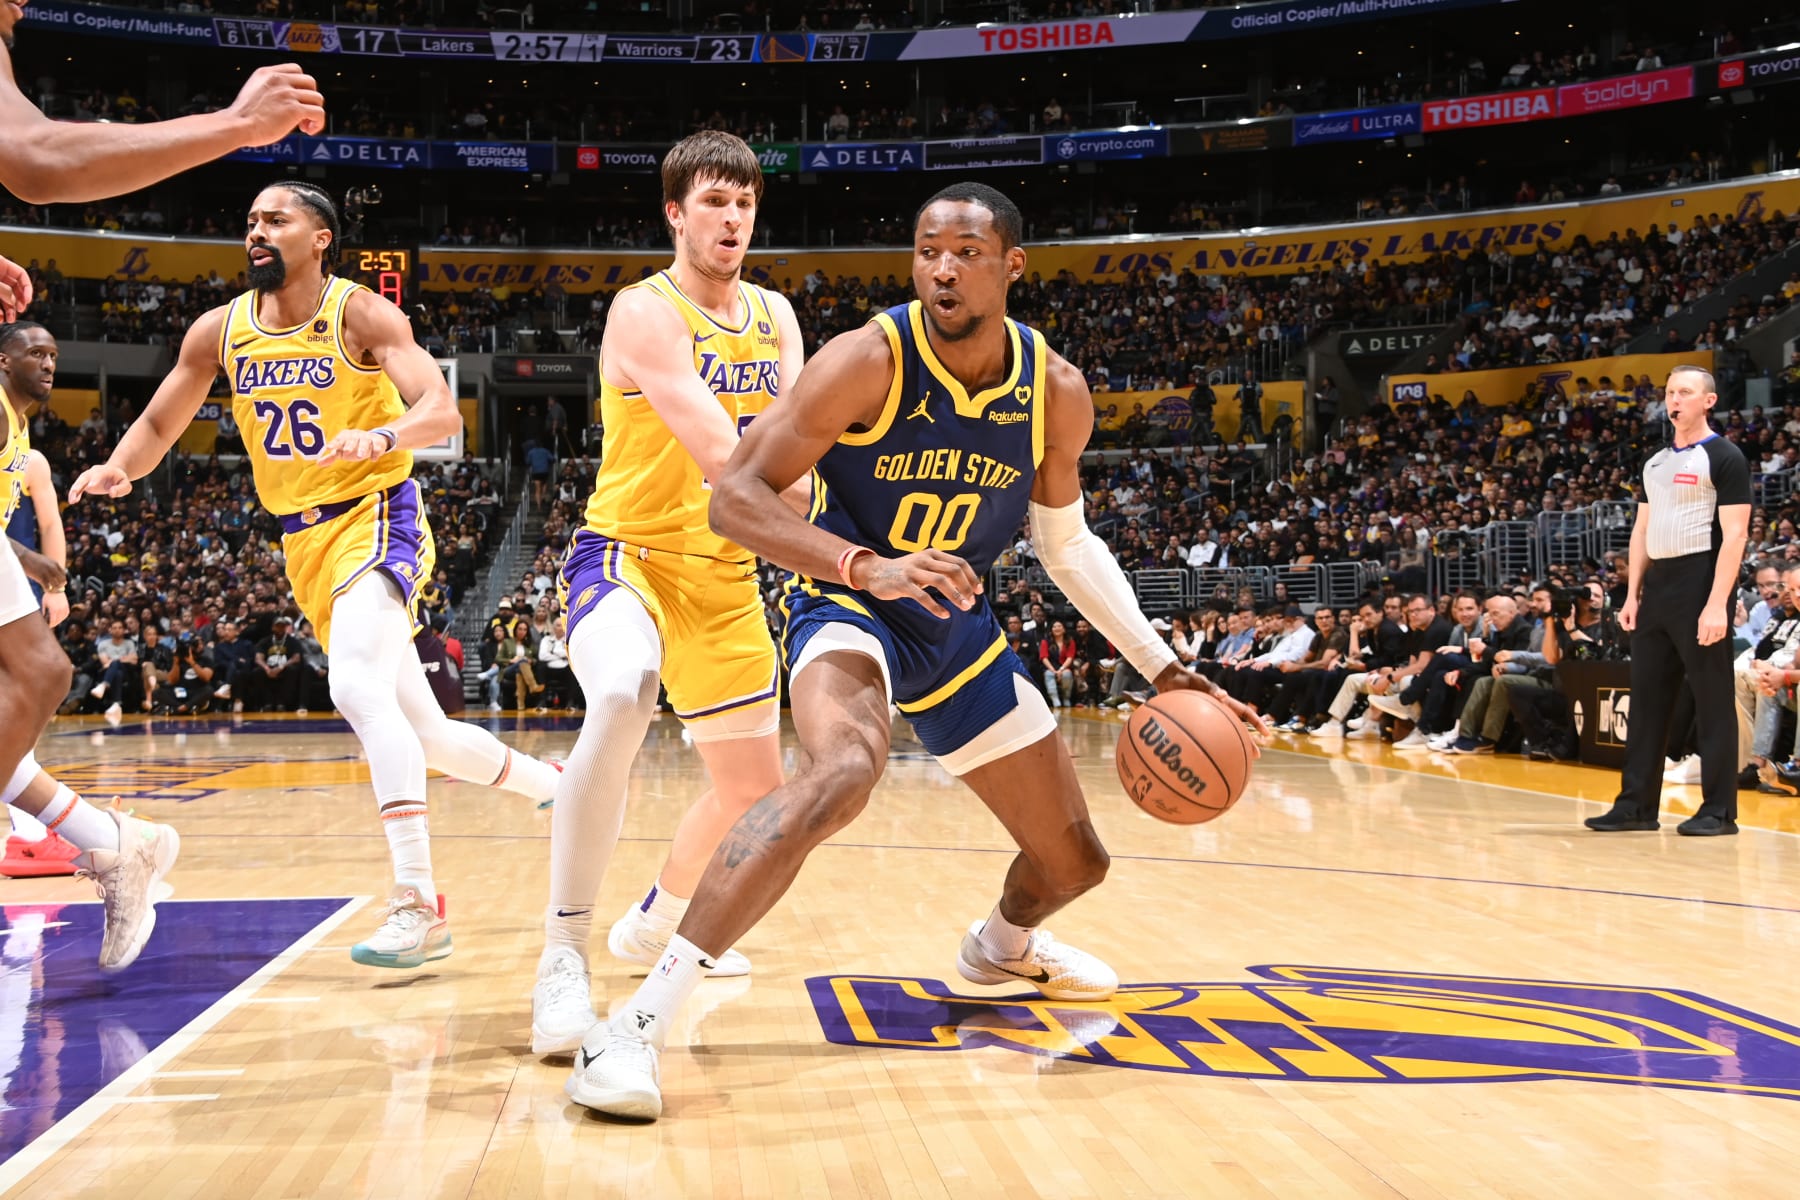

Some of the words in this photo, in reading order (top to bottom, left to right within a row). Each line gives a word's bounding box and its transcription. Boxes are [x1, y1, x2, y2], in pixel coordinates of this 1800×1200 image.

[23, 7, 69, 23] fficial
[73, 12, 212, 37] Copier/Multi-Func
[1232, 12, 1282, 29] Official
[228, 30, 238, 44] 6
[256, 32, 264, 45] 1
[354, 30, 384, 52] 17
[422, 38, 474, 52] Lakers
[979, 21, 1115, 52] TOSHIBA
[505, 35, 569, 60] 2:57
[588, 43, 597, 61] 1
[617, 43, 682, 57] Warriors
[711, 39, 741, 61] 23
[824, 45, 833, 59] 3
[849, 45, 859, 59] 7
[1749, 57, 1800, 76] TOYOT
[1582, 77, 1669, 104] boldyn
[1428, 95, 1549, 126] TOSHIBA
[1362, 113, 1414, 130] ULTRA
[339, 144, 419, 162] DELTA
[457, 146, 526, 157] AMERICAN
[1079, 137, 1154, 152] crypto.com
[467, 157, 528, 167] EXPRESS
[603, 153, 657, 165] TOYOTA
[757, 149, 788, 166] rite
[837, 150, 914, 165] DELTA
[1092, 251, 1173, 274] LOS
[1188, 238, 1372, 269] ANGELES
[1382, 220, 1566, 256] LAKERS
[360, 251, 405, 271] 2:57
[307, 334, 334, 344] bibigo
[757, 336, 778, 348] bibig
[235, 355, 336, 394] LAKERS
[536, 364, 572, 373] TOYOTA
[1395, 384, 1424, 400] 108
[197, 404, 219, 419] 06
[988, 411, 1029, 423] Rakuten
[254, 399, 326, 457] 26
[873, 448, 962, 482] GOLDEN
[963, 453, 1022, 489] STATE
[887, 491, 982, 553] 00
[1139, 717, 1208, 797] Wilson
